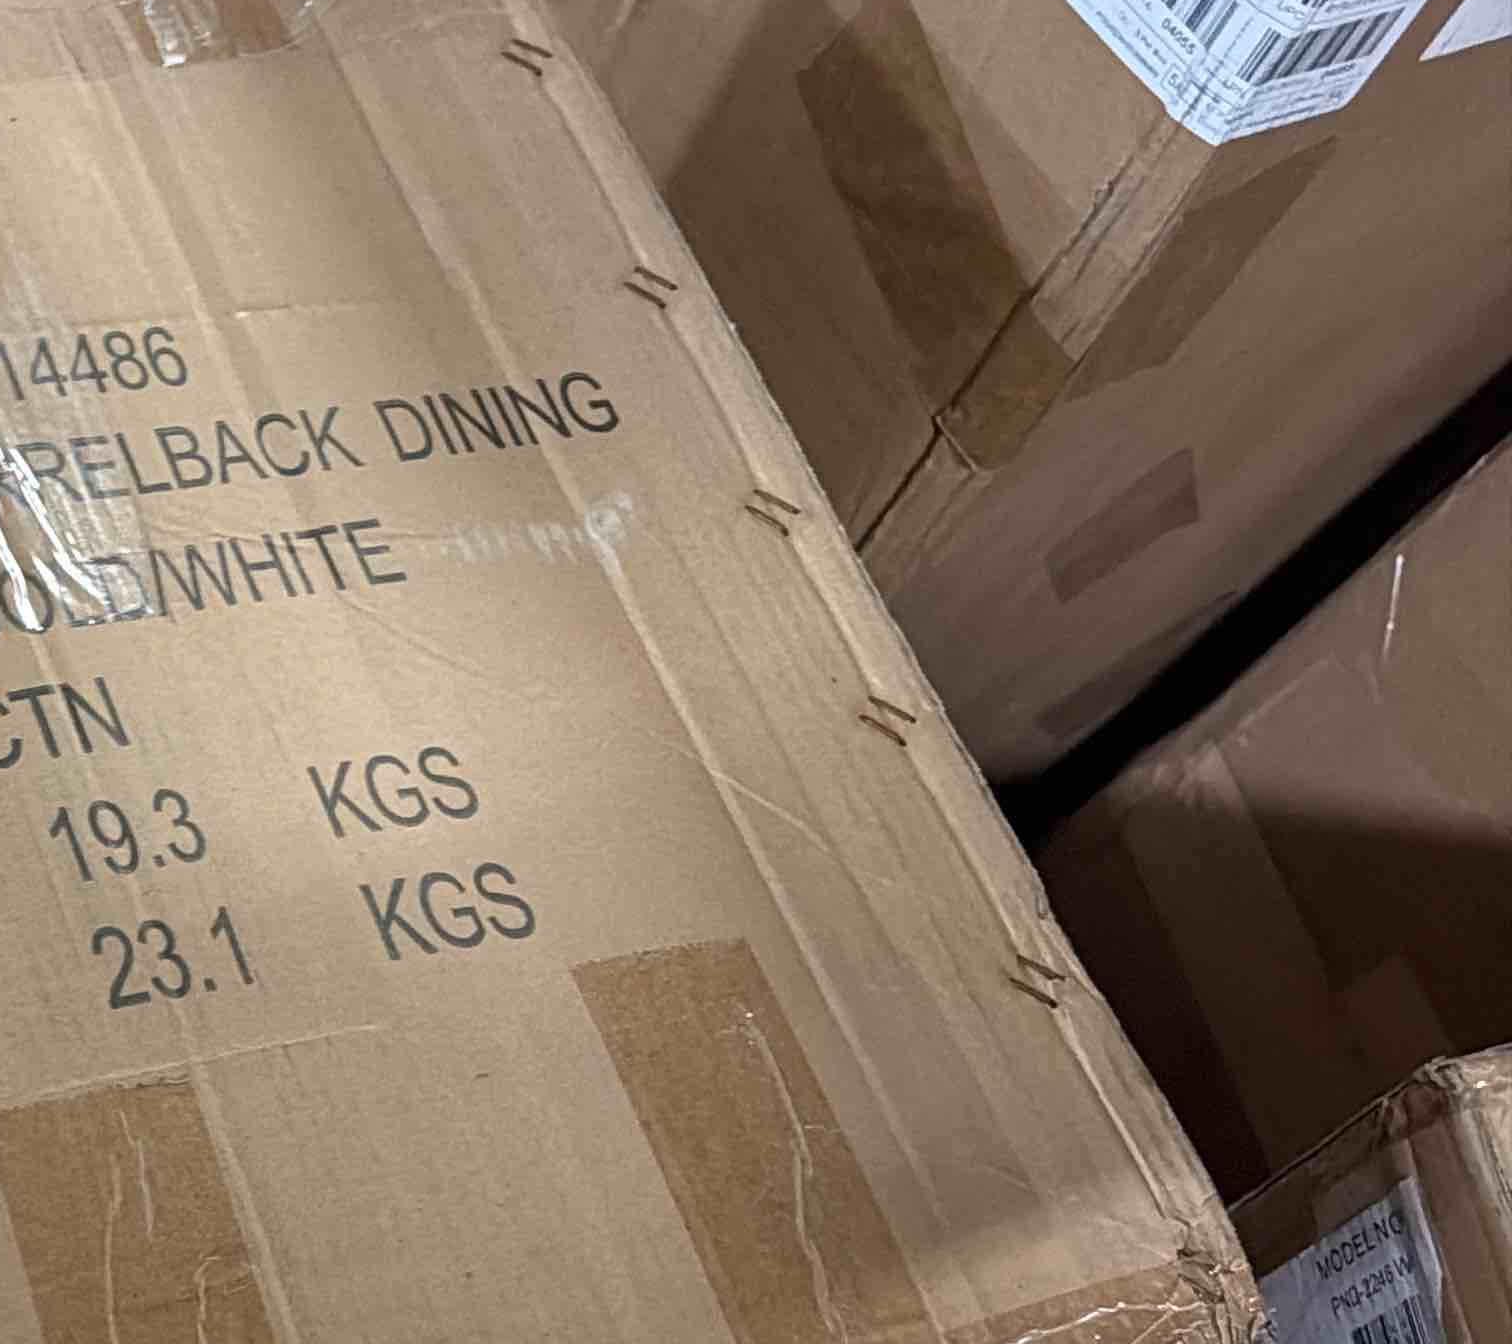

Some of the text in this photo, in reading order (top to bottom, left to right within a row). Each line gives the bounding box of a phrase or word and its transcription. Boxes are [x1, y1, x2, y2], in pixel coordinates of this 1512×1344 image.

[373, 371, 620, 463] DINING
[47, 787, 208, 882] 19.3
[307, 745, 480, 839] KGS
[91, 905, 259, 1011] 23.1
[359, 861, 538, 961] KGS
